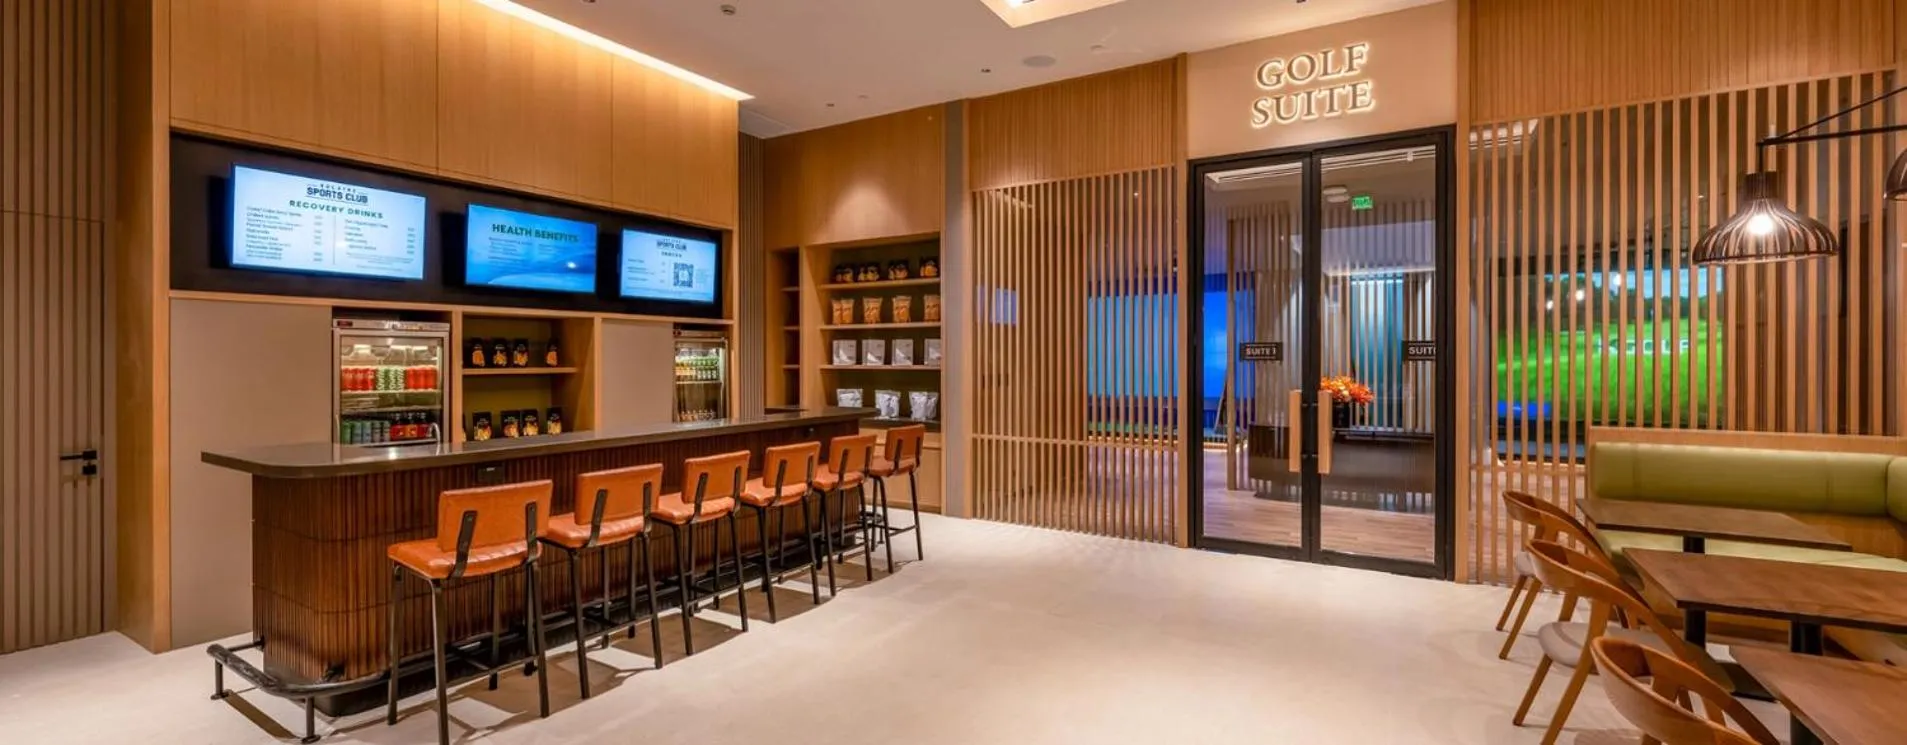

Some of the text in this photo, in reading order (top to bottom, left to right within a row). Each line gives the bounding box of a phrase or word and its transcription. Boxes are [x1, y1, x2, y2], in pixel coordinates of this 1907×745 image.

[1256, 43, 1367, 88] GOLF
[1251, 81, 1374, 127] SUITE
[306, 187, 368, 203] SPORTS CLUB
[289, 200, 345, 213] RECOVERY
[347, 208, 383, 219] DRINKS
[492, 223, 532, 236] HEALTH
[534, 229, 579, 242] BENEFITS
[1246, 347, 1270, 356] SUITE
